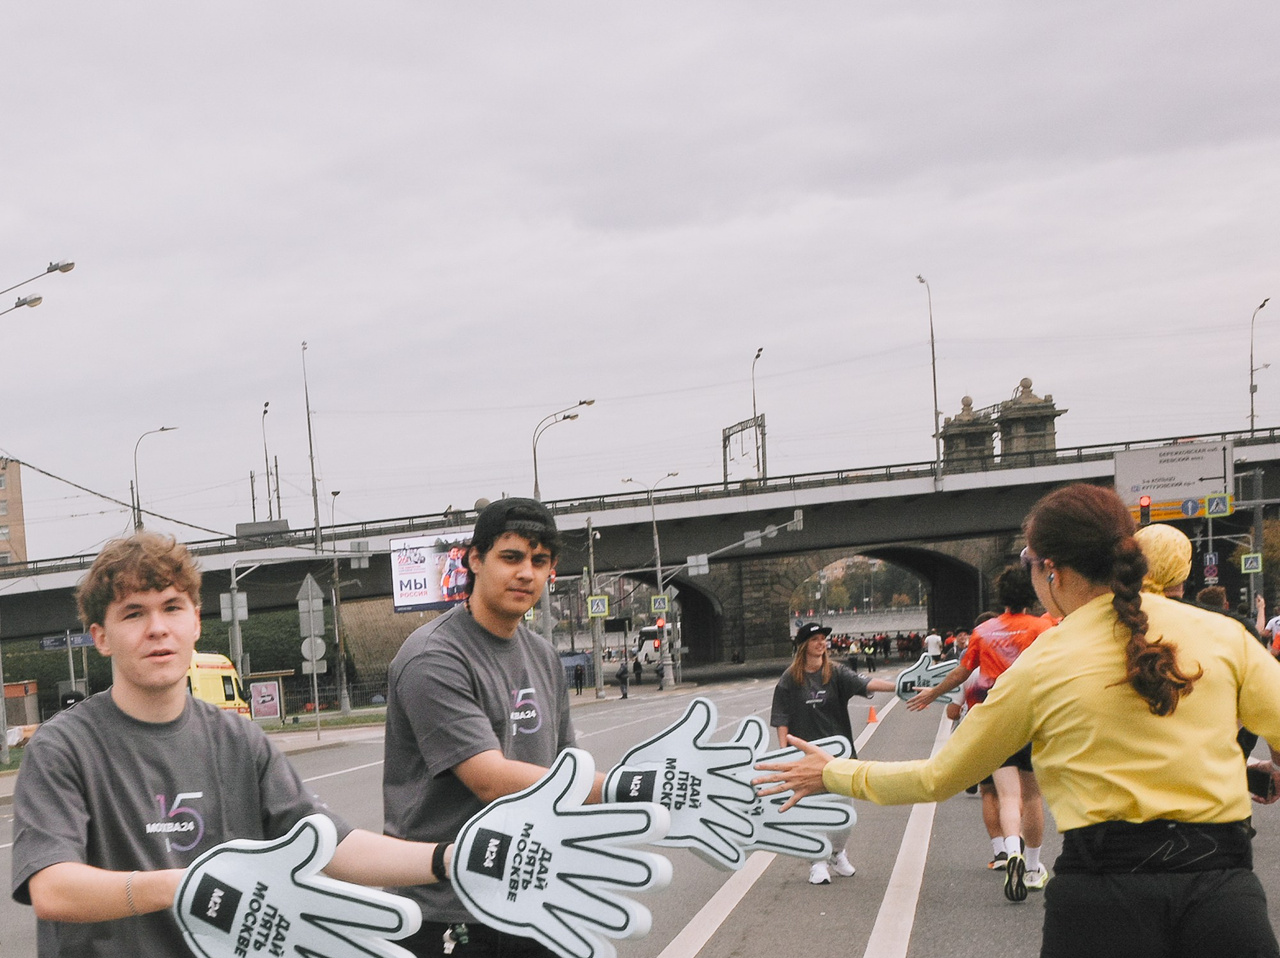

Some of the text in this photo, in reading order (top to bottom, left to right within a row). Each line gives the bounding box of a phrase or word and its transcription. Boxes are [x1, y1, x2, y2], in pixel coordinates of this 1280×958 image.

[400, 578, 427, 591] МЫ
[674, 770, 689, 810] ПЯТЬ
[689, 775, 702, 809] ДАЙ
[506, 822, 534, 903] МОСКВЕ
[521, 840, 542, 890] ПЯТЬ
[534, 847, 553, 891] ДАЙ
[234, 881, 268, 958] МОСКВЕ
[252, 904, 278, 952] ПЯТЬ
[268, 914, 291, 958] ДАЙ
